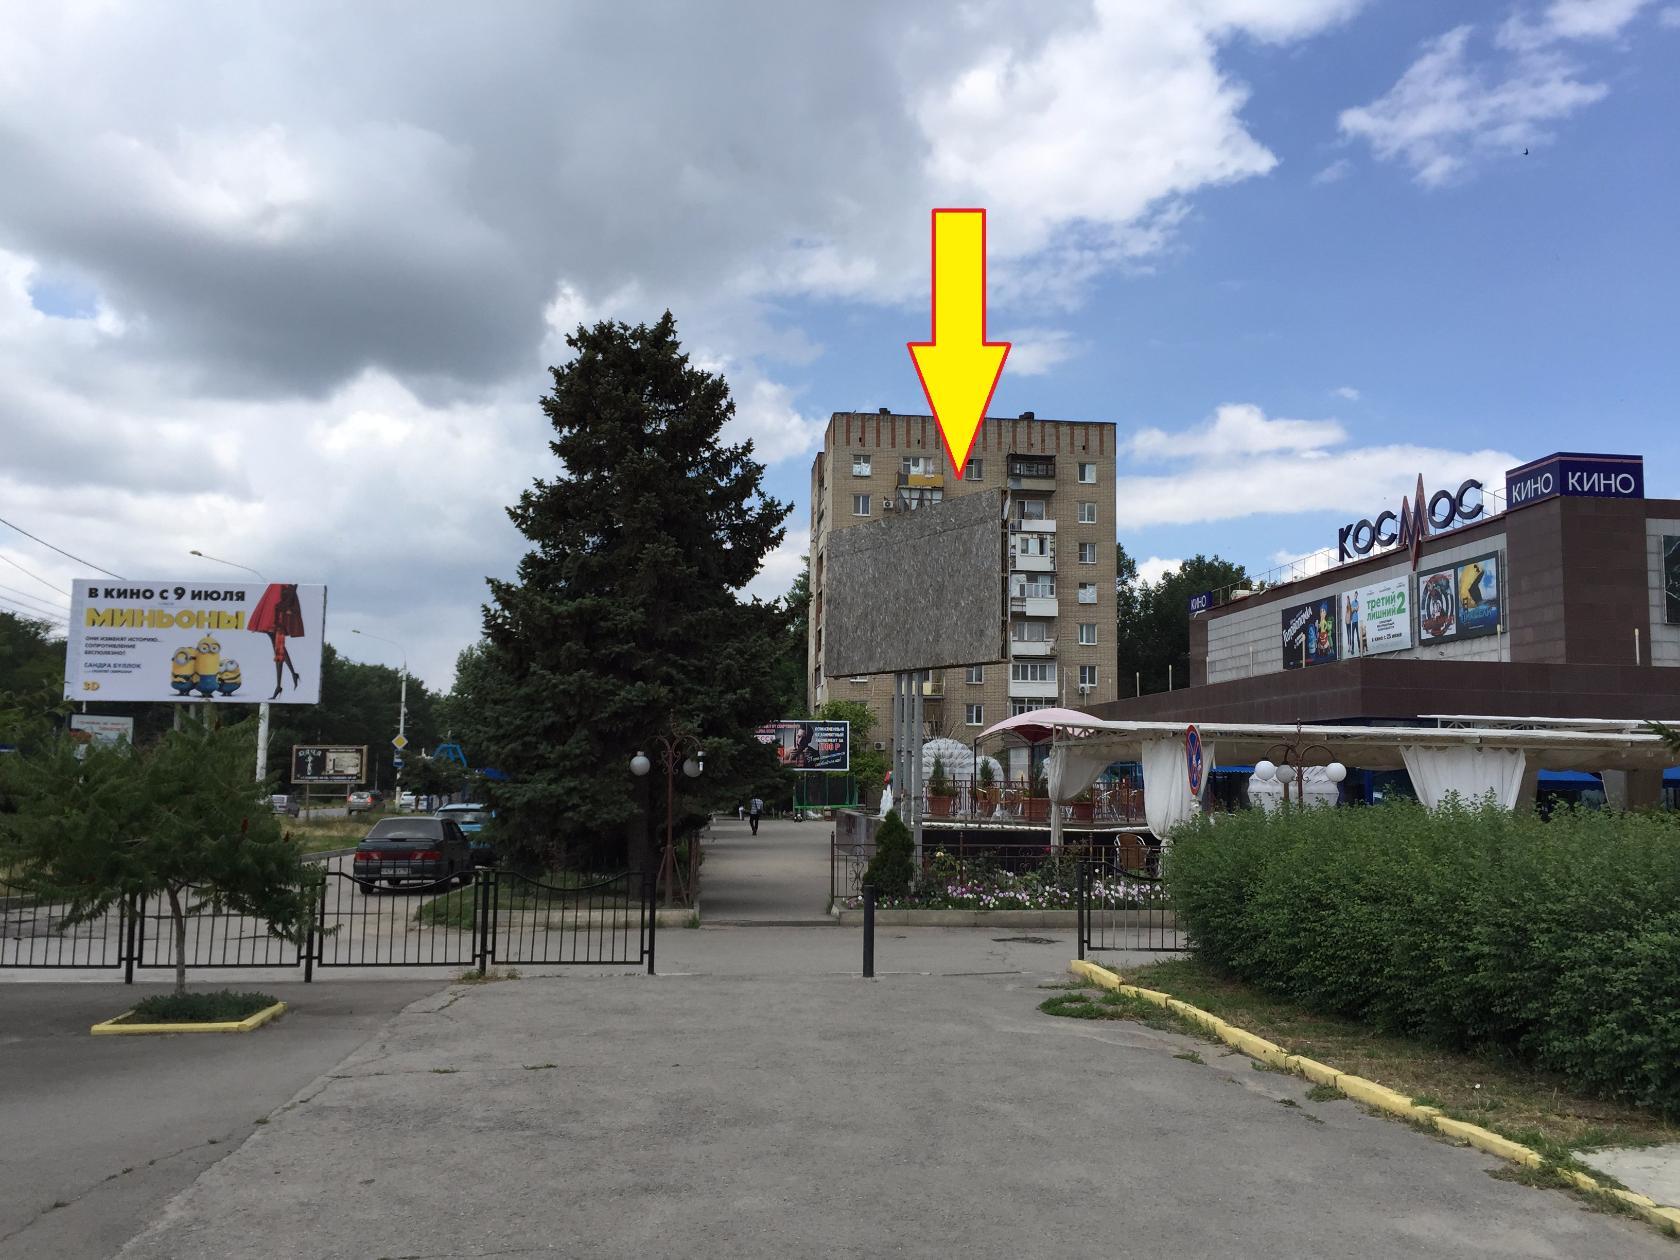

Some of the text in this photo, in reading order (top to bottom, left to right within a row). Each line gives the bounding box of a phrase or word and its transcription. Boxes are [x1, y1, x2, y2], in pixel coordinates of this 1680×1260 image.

[1512, 473, 1553, 503] КИНО
[1568, 472, 1635, 494] КИНО
[1339, 473, 1484, 571] КОСМОС
[173, 586, 186, 601] 9
[1190, 595, 1207, 611] КИНО
[1366, 590, 1396, 612] третий
[1366, 591, 1407, 622] лишний 2
[85, 607, 246, 630] МИНЬОНЫ
